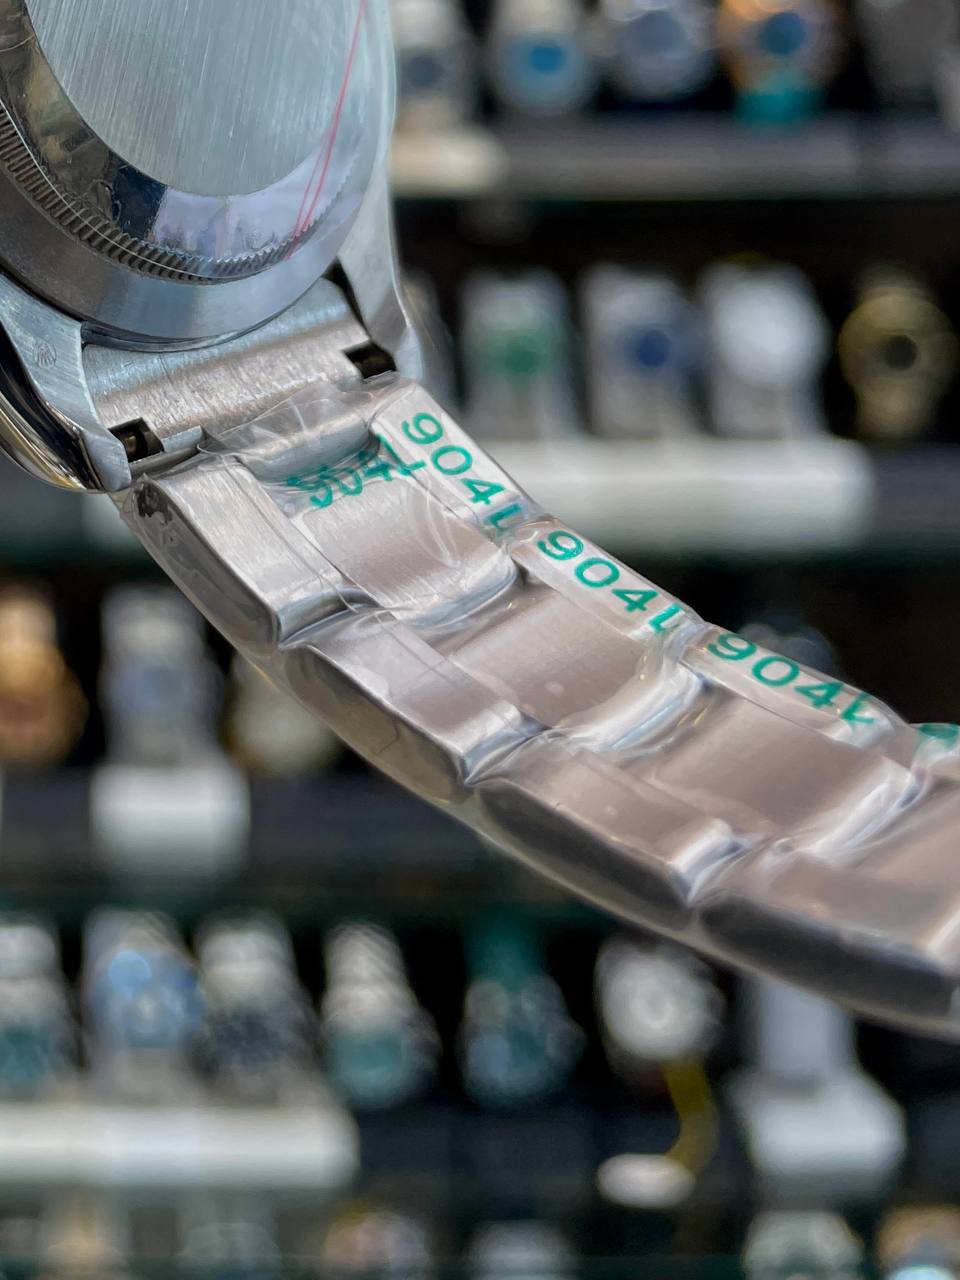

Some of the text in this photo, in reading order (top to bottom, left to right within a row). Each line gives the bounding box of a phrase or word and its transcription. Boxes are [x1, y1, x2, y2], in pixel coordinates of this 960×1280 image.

[401, 412, 522, 530] 904L
[537, 530, 683, 633] 904L
[707, 633, 876, 725] 904L
